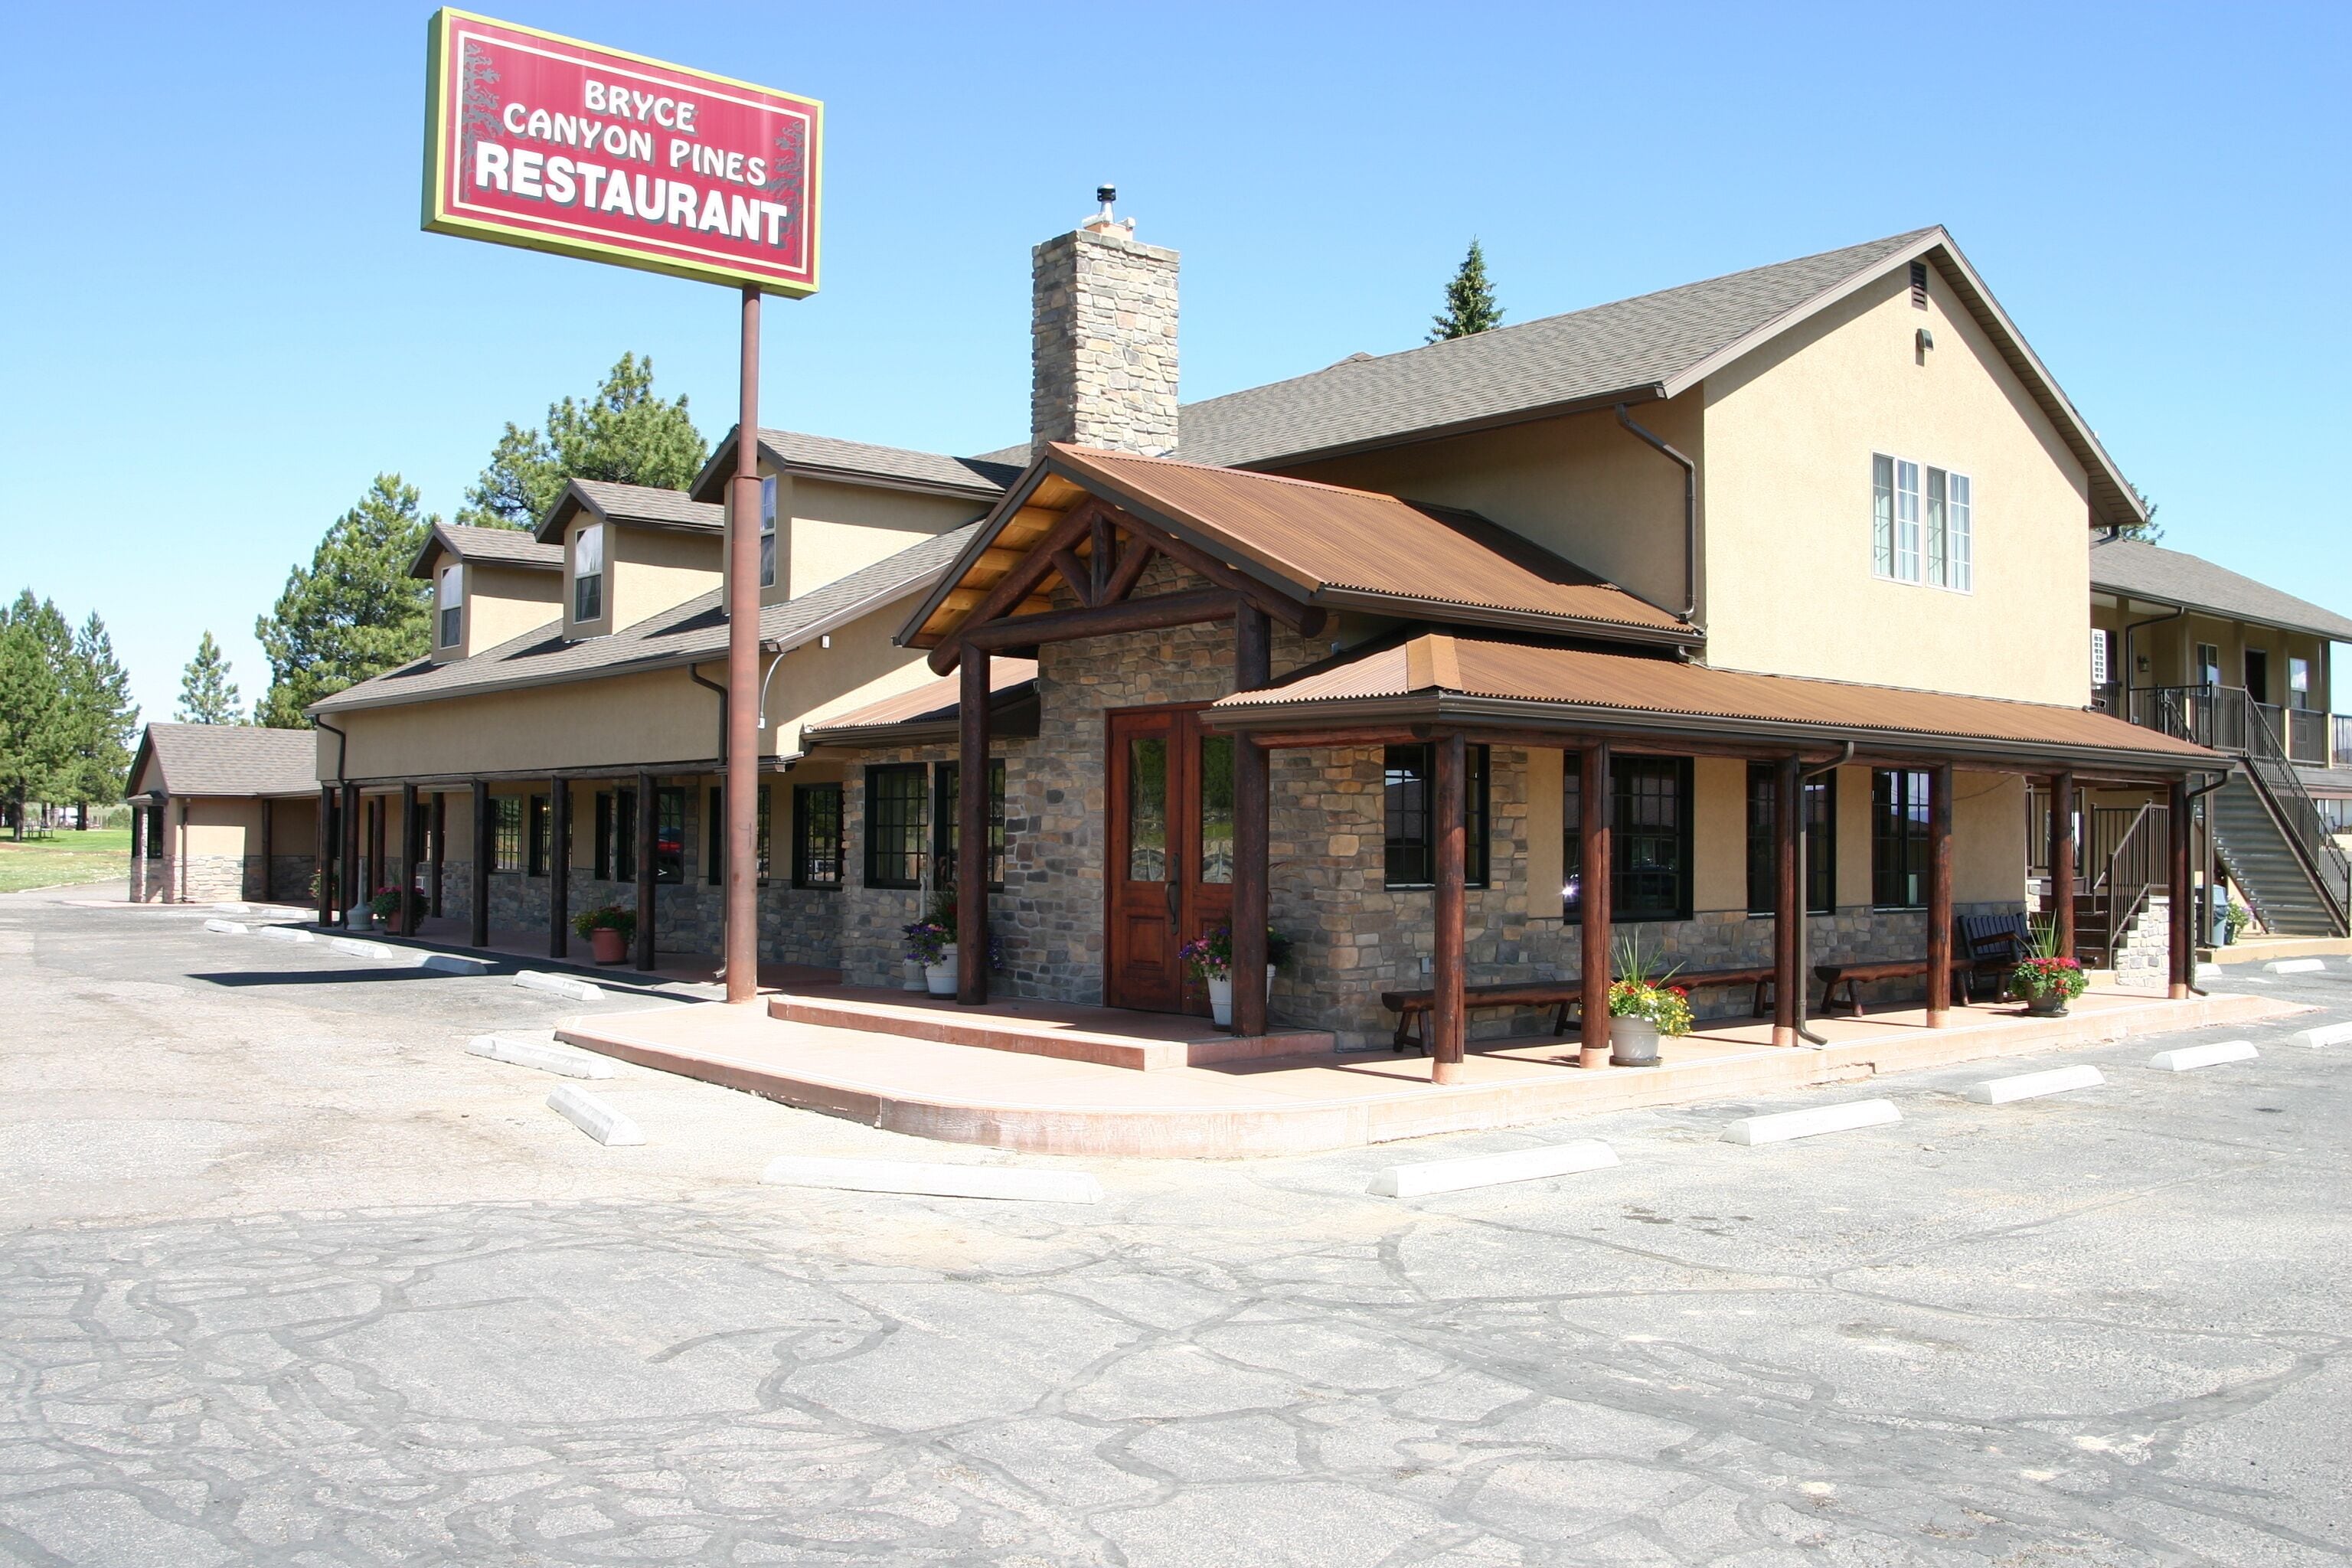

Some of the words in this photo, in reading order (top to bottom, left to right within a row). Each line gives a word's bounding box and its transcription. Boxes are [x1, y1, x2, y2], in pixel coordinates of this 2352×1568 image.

[503, 103, 652, 162] CANYON
[670, 139, 766, 186] PINES
[585, 80, 696, 132] BRYCE
[475, 141, 788, 245] RESTAURANT
